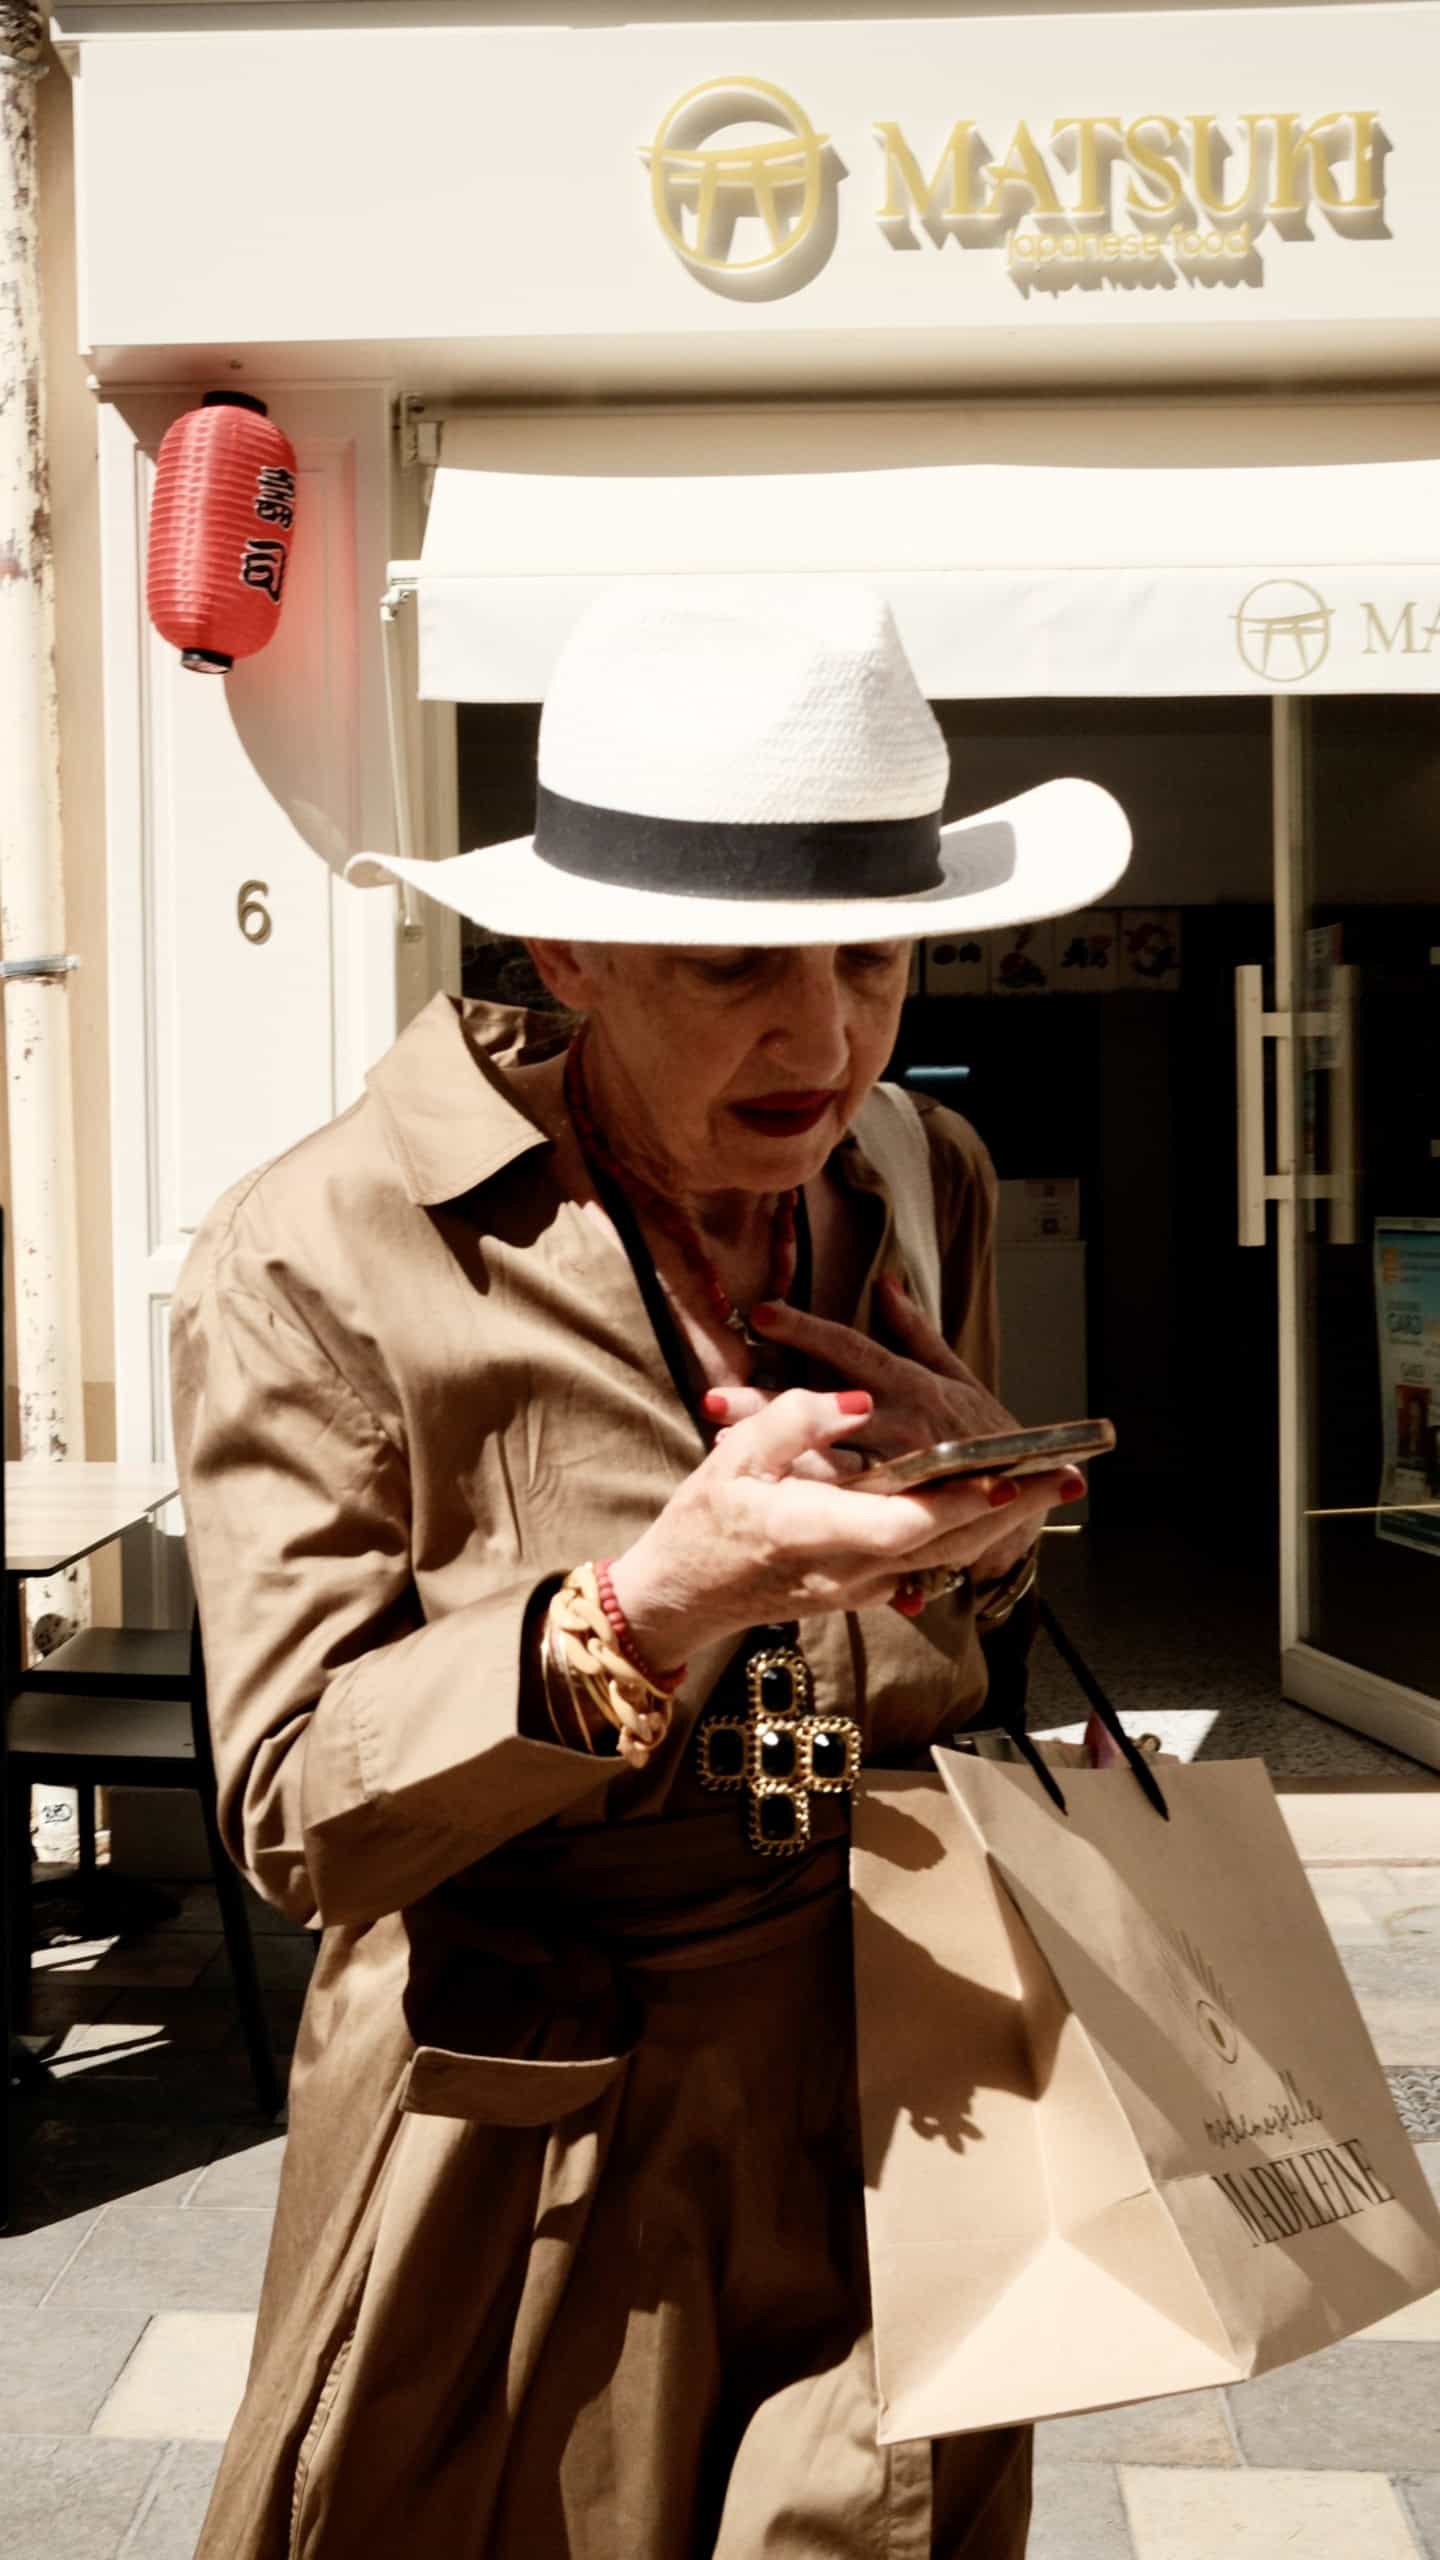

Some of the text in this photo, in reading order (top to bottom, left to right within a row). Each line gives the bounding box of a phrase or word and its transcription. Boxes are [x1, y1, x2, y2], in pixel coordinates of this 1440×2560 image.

[871, 112, 1380, 216] MATSUKI
[1006, 222, 1250, 268] japanese food
[237, 879, 272, 945] 6
[1211, 2137, 1396, 2249] MADELEINE
